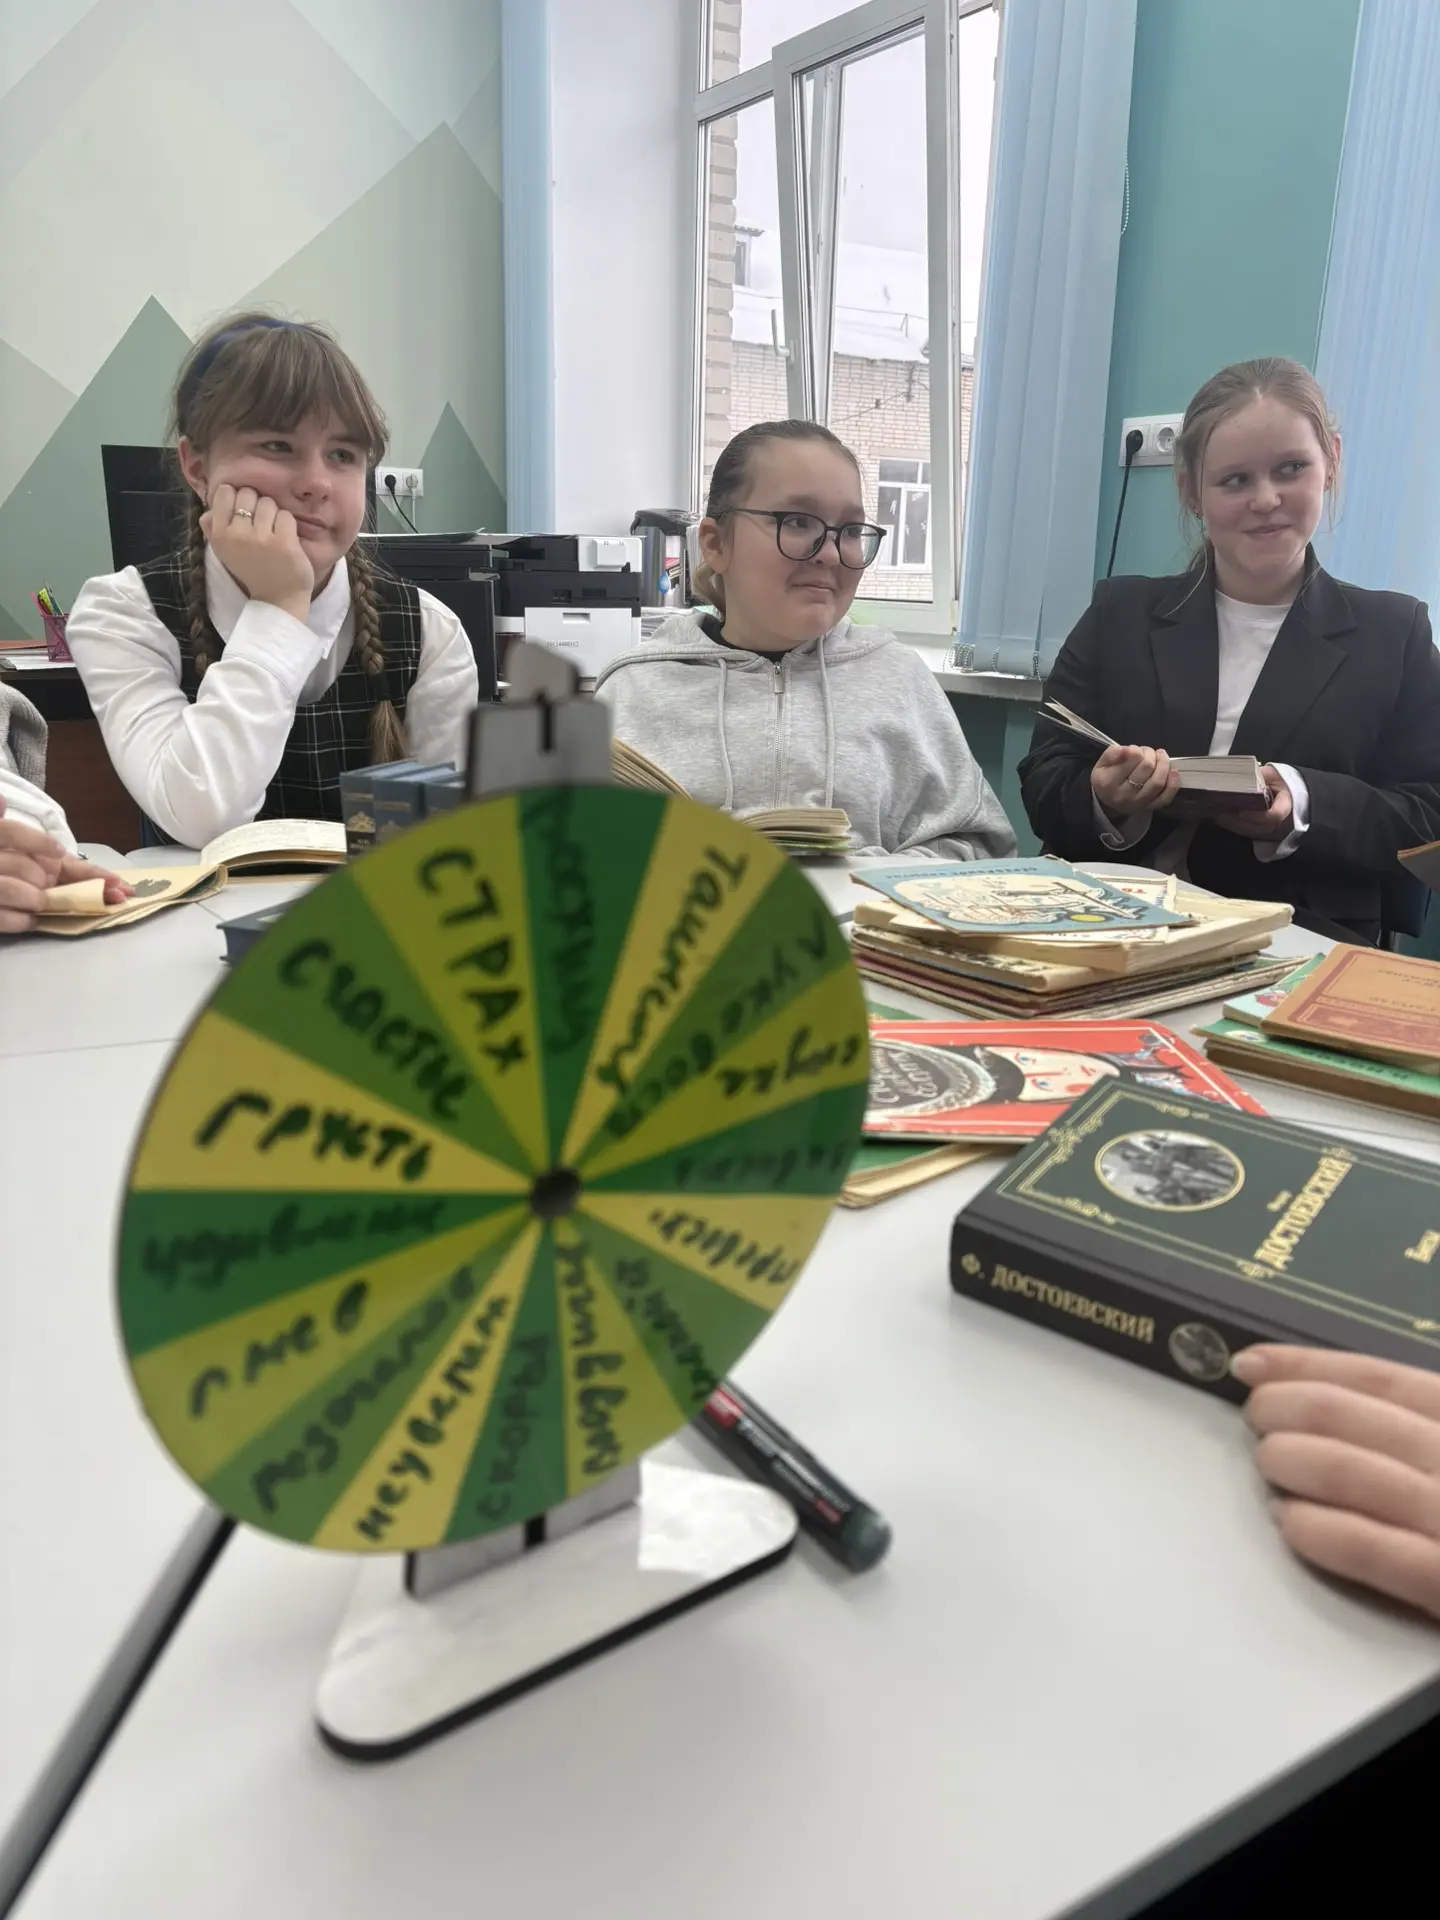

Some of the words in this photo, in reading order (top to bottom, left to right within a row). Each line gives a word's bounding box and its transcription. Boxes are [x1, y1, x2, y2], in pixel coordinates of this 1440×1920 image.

[418, 849, 526, 1076] СТРАХ
[1253, 1156, 1353, 1272] ДОСТОЕВСКИЙ
[990, 1263, 1156, 1345] ДОСТОЕВСКИЙ
